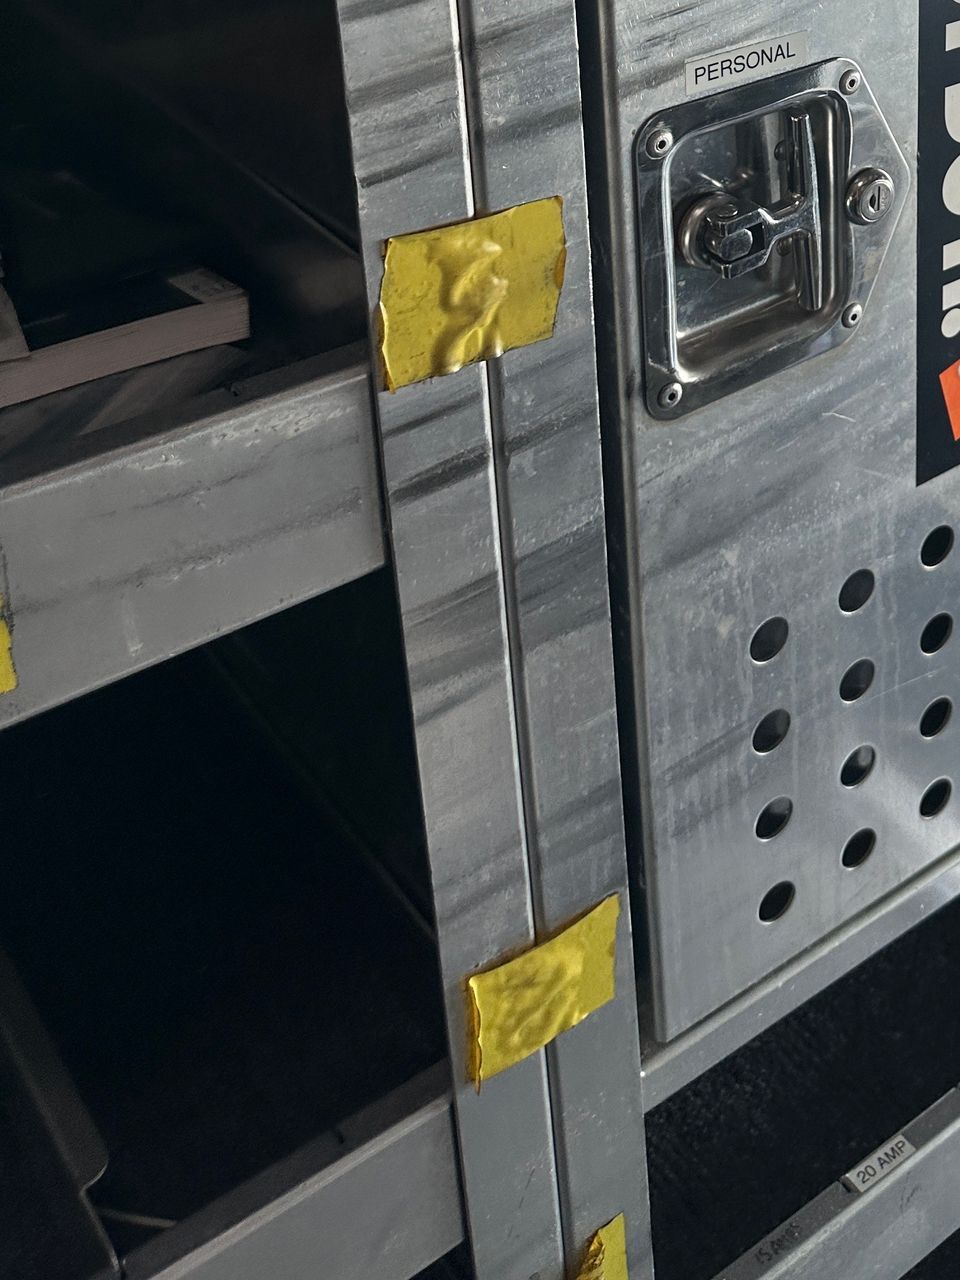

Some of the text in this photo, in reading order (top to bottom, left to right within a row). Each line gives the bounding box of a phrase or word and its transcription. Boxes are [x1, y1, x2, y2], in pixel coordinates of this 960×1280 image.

[694, 41, 796, 85] PERSONAL
[856, 1140, 907, 1184] 20 AMP
